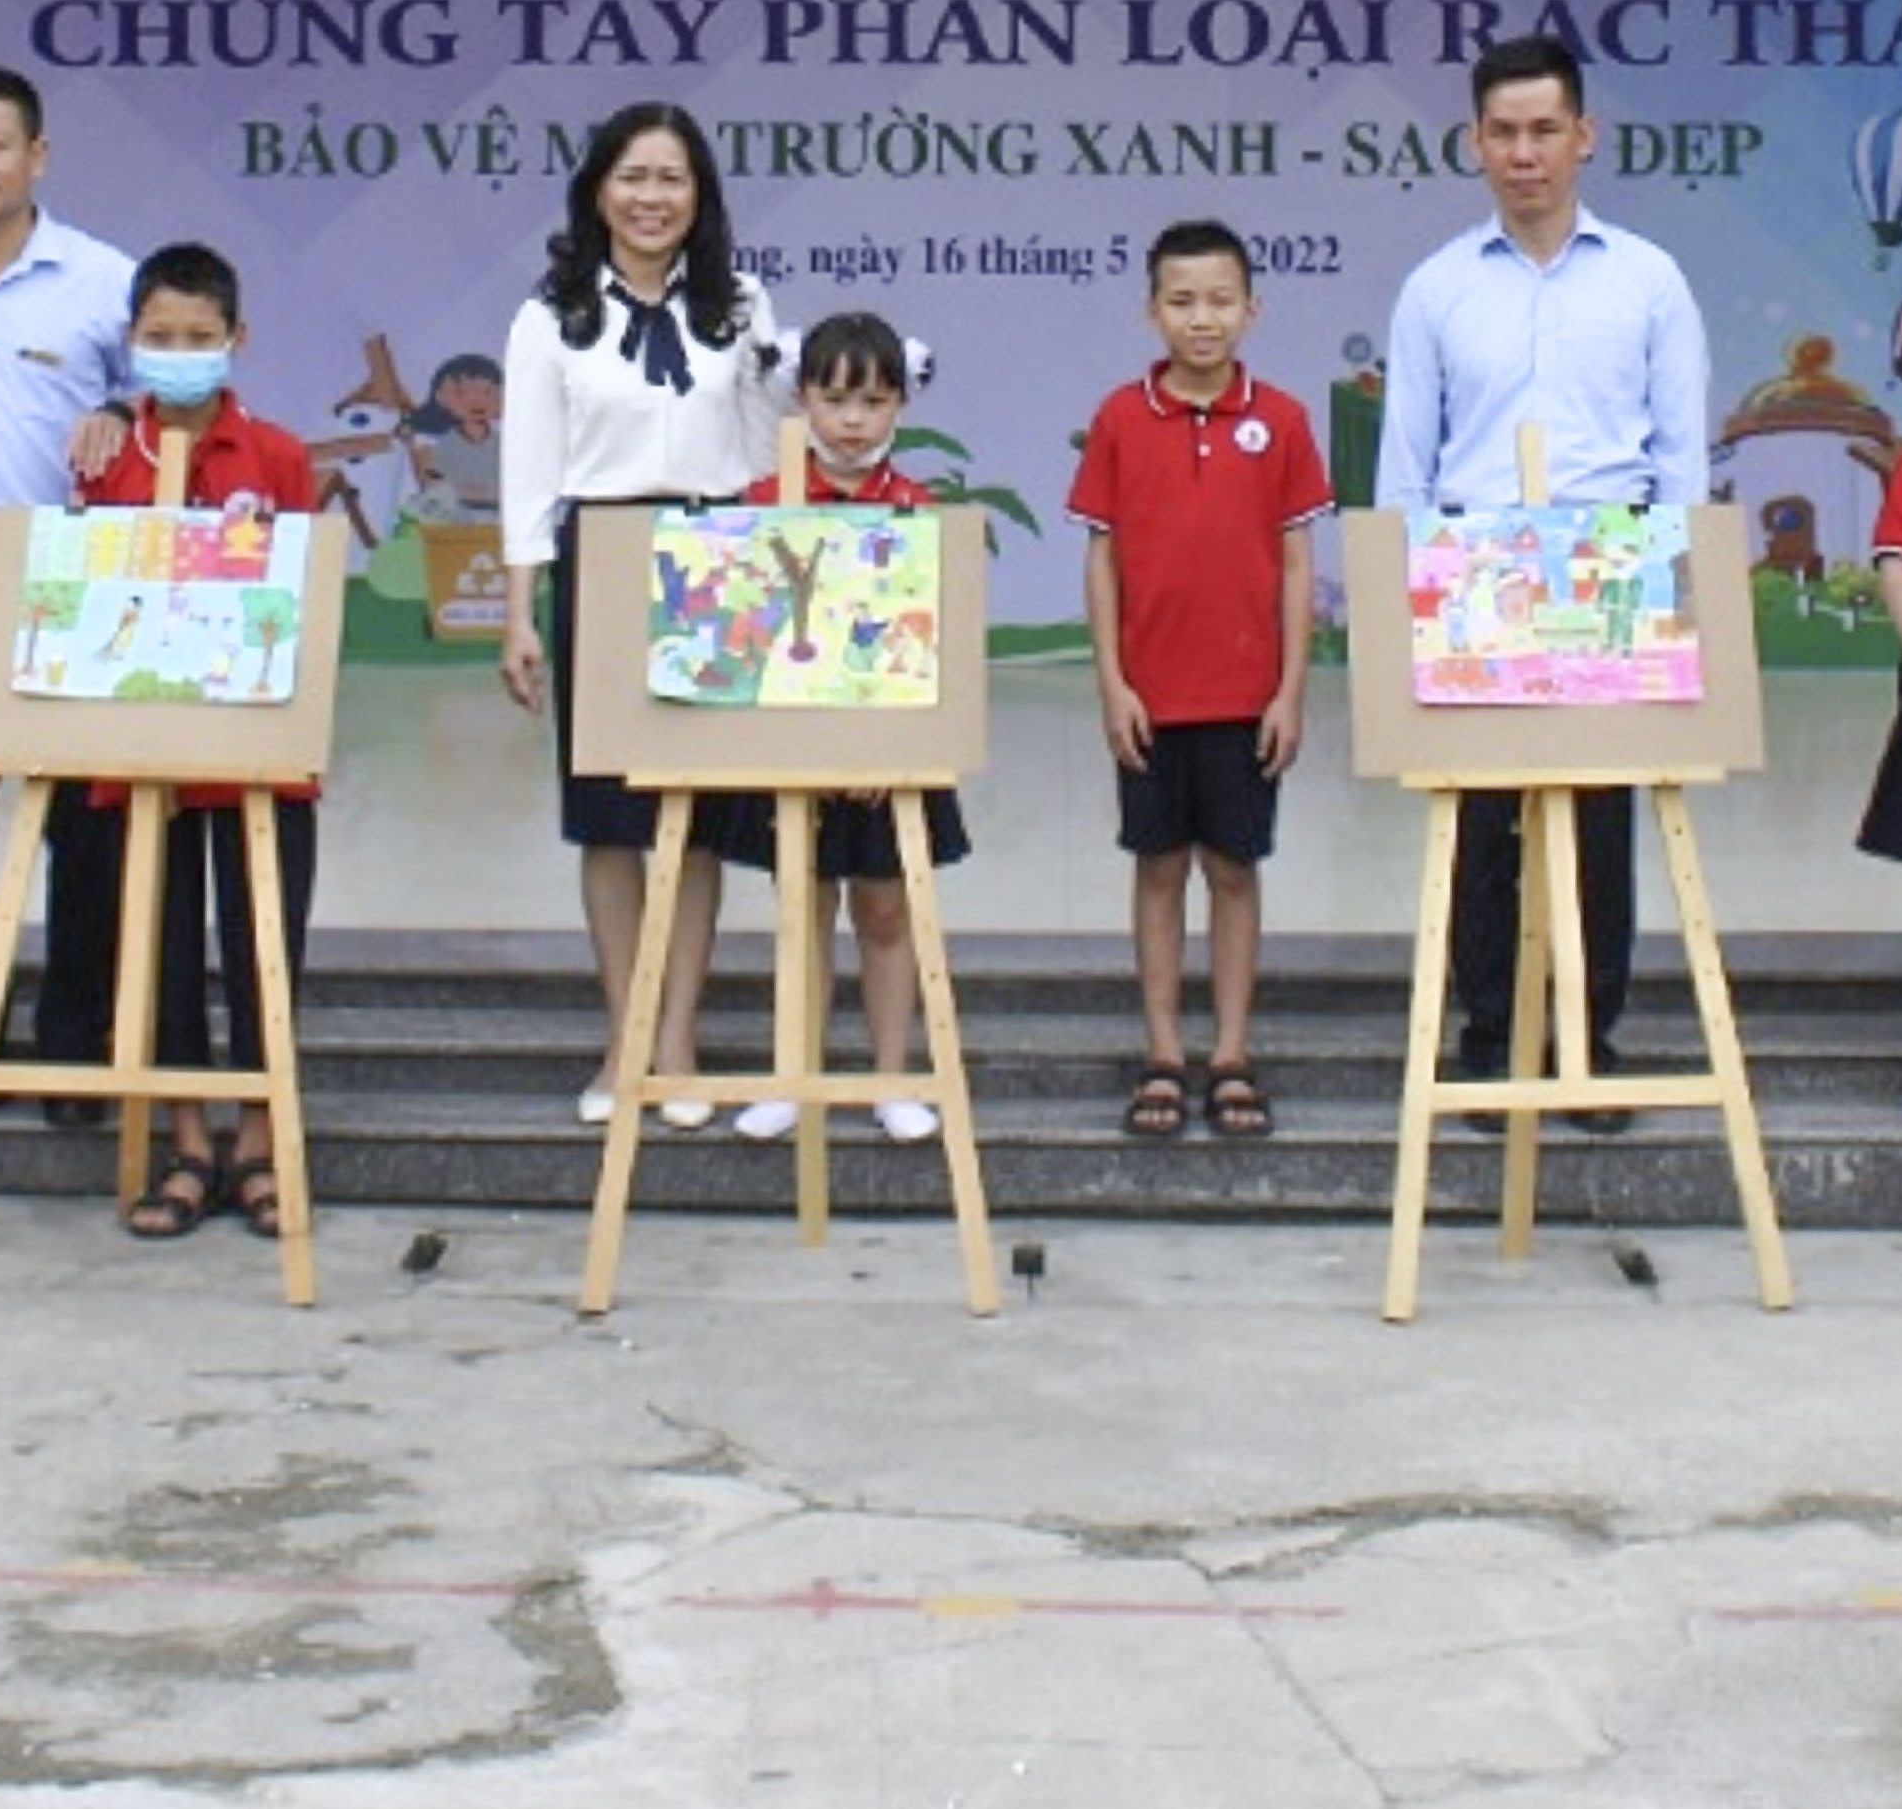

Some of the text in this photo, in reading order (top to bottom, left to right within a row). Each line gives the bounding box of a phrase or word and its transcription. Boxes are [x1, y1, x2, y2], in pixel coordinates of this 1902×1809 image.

[241, 102, 399, 180] BẢO
[420, 104, 521, 192] VỆ
[716, 105, 1039, 179] TRƯỜNG
[1063, 120, 1279, 179] XANH
[1342, 120, 1484, 192] SẠC
[1615, 121, 1766, 192] ĐẸP
[808, 233, 903, 287] ngày
[922, 234, 968, 276] 16
[977, 233, 1096, 287] tháng
[1105, 233, 1129, 276] 5
[1248, 234, 1342, 274] 2022
